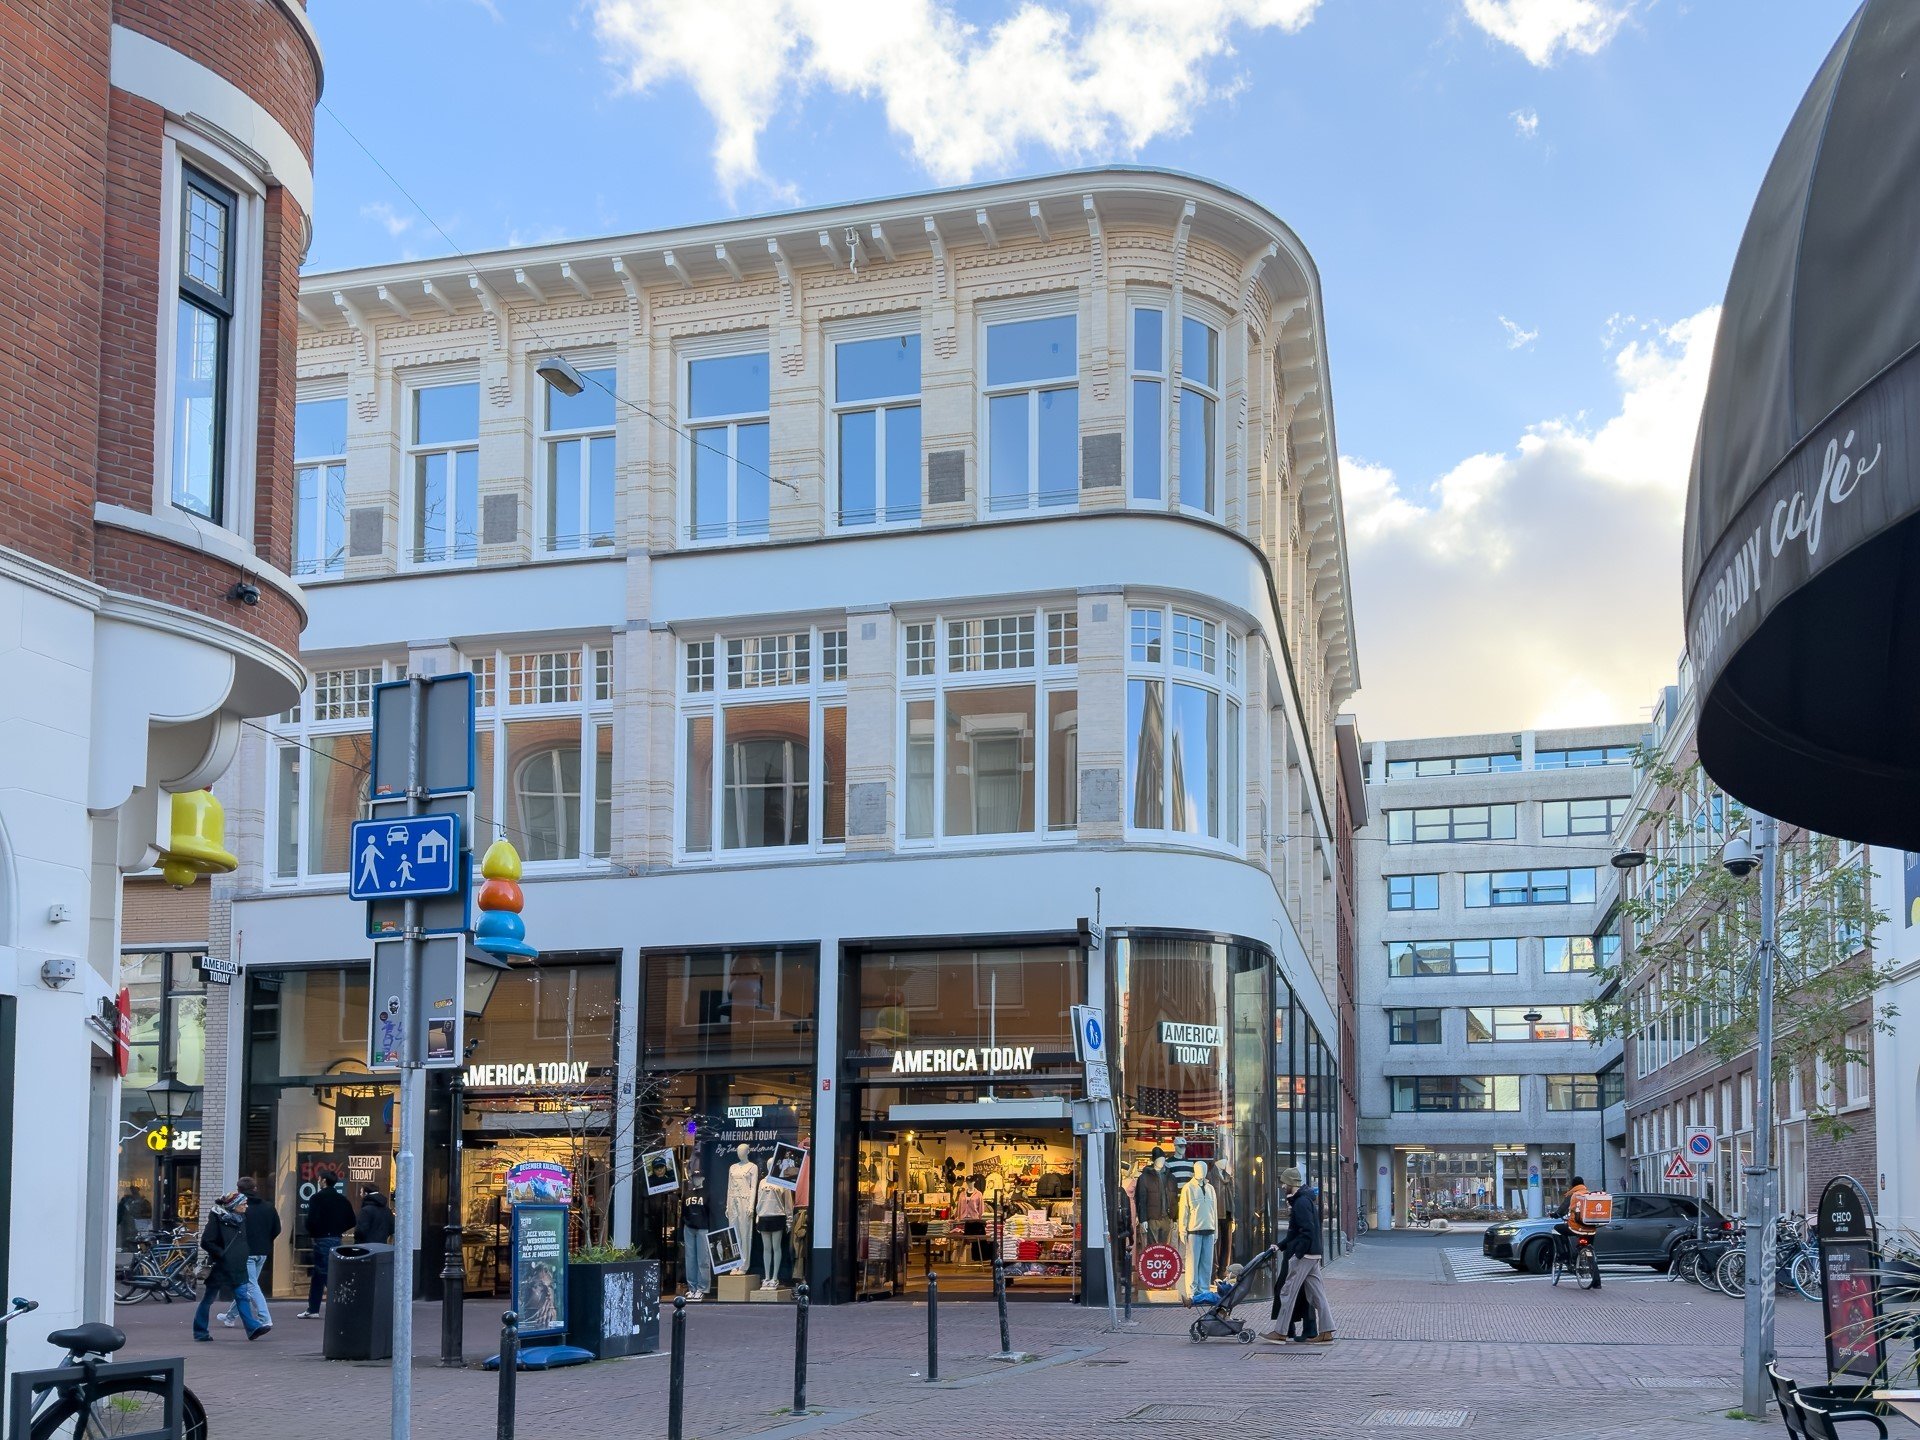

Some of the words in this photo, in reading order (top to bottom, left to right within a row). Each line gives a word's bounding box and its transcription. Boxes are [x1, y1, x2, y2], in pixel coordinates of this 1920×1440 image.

[1695, 526, 1761, 671] COMPANY
[1770, 429, 1881, 556] café
[204, 958, 237, 973] AMERICA
[210, 970, 231, 984] TODAY
[1164, 1024, 1221, 1044] AMERICA
[892, 1049, 978, 1073] AMERICA
[981, 1047, 1034, 1071] TODAY
[1176, 1046, 1210, 1064] TODAY
[539, 1062, 589, 1084] TODAY
[730, 1108, 761, 1117] AMERICA
[340, 1118, 368, 1126] AMERICA
[735, 1118, 755, 1127] TODAY
[345, 1127, 363, 1136] TODAY
[720, 1131, 753, 1141] AMERICA
[755, 1130, 778, 1140] TODAY
[348, 1157, 380, 1167] MERICA
[352, 1170, 373, 1180] TODAY
[685, 1196, 704, 1207] USA
[1147, 1260, 1172, 1269] 50%
[1151, 1270, 1167, 1279] off
